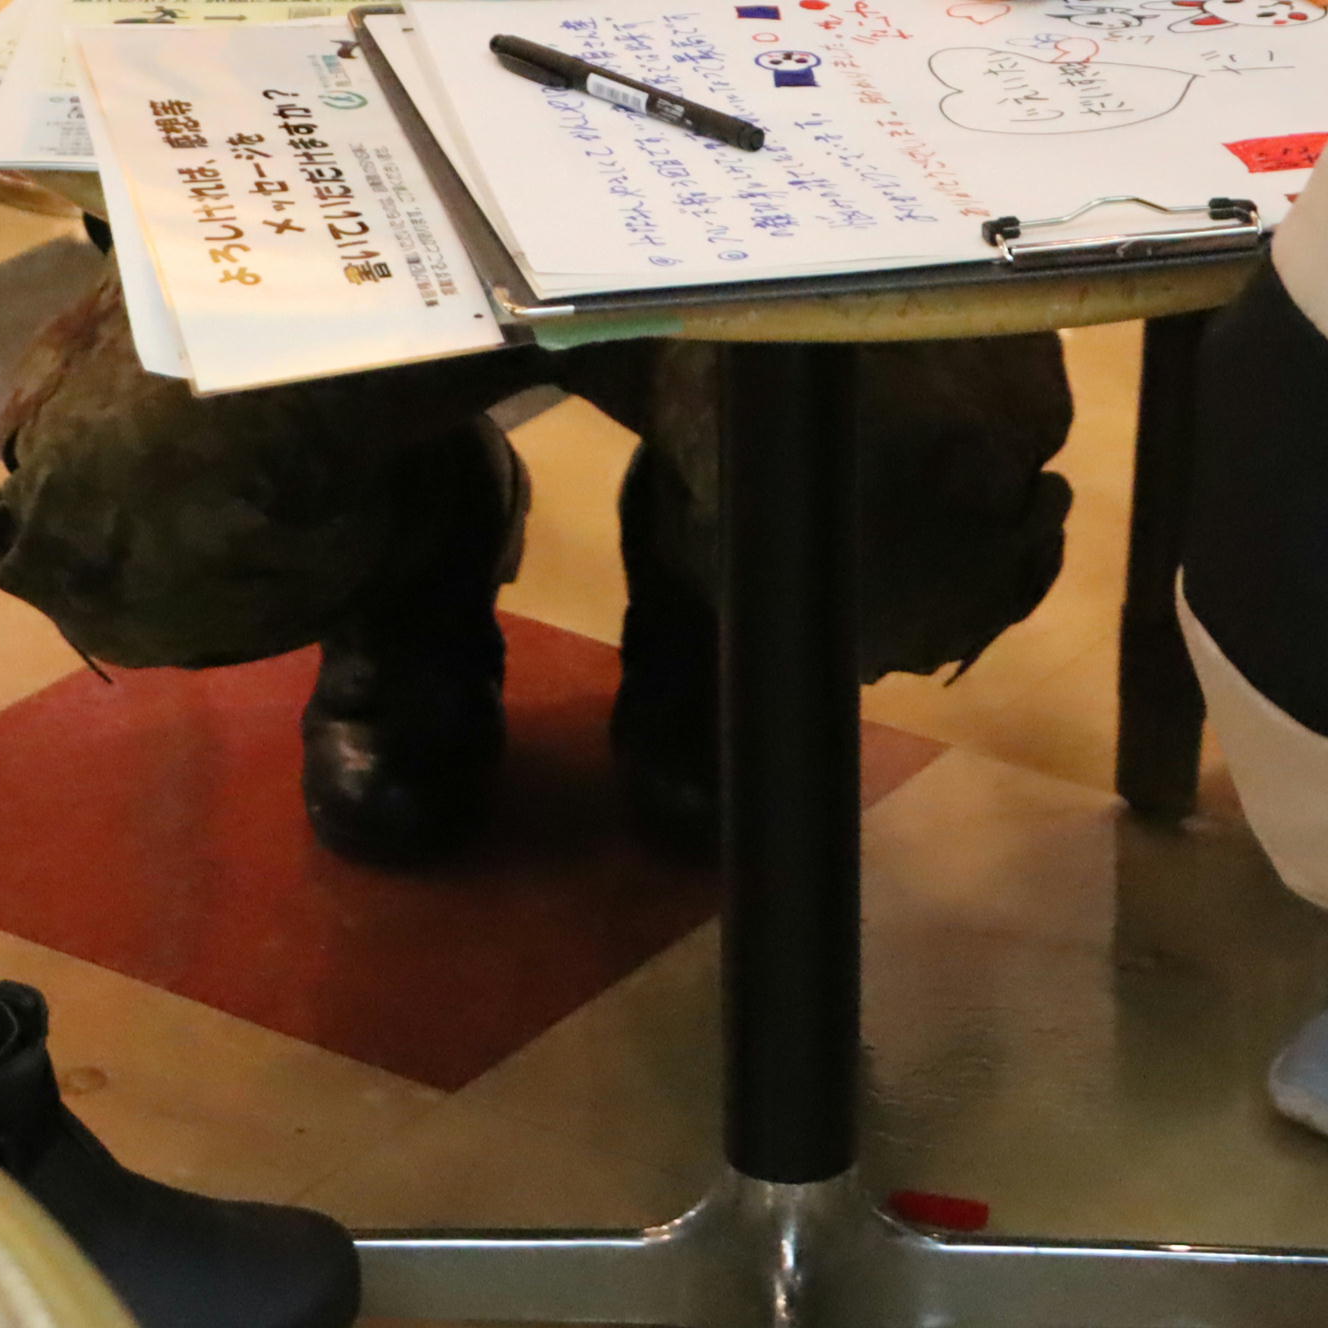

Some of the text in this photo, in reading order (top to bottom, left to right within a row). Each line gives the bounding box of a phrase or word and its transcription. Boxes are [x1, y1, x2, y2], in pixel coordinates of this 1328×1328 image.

[149, 98, 261, 287] よろしければ、感想等
[225, 131, 306, 235] メッセージを
